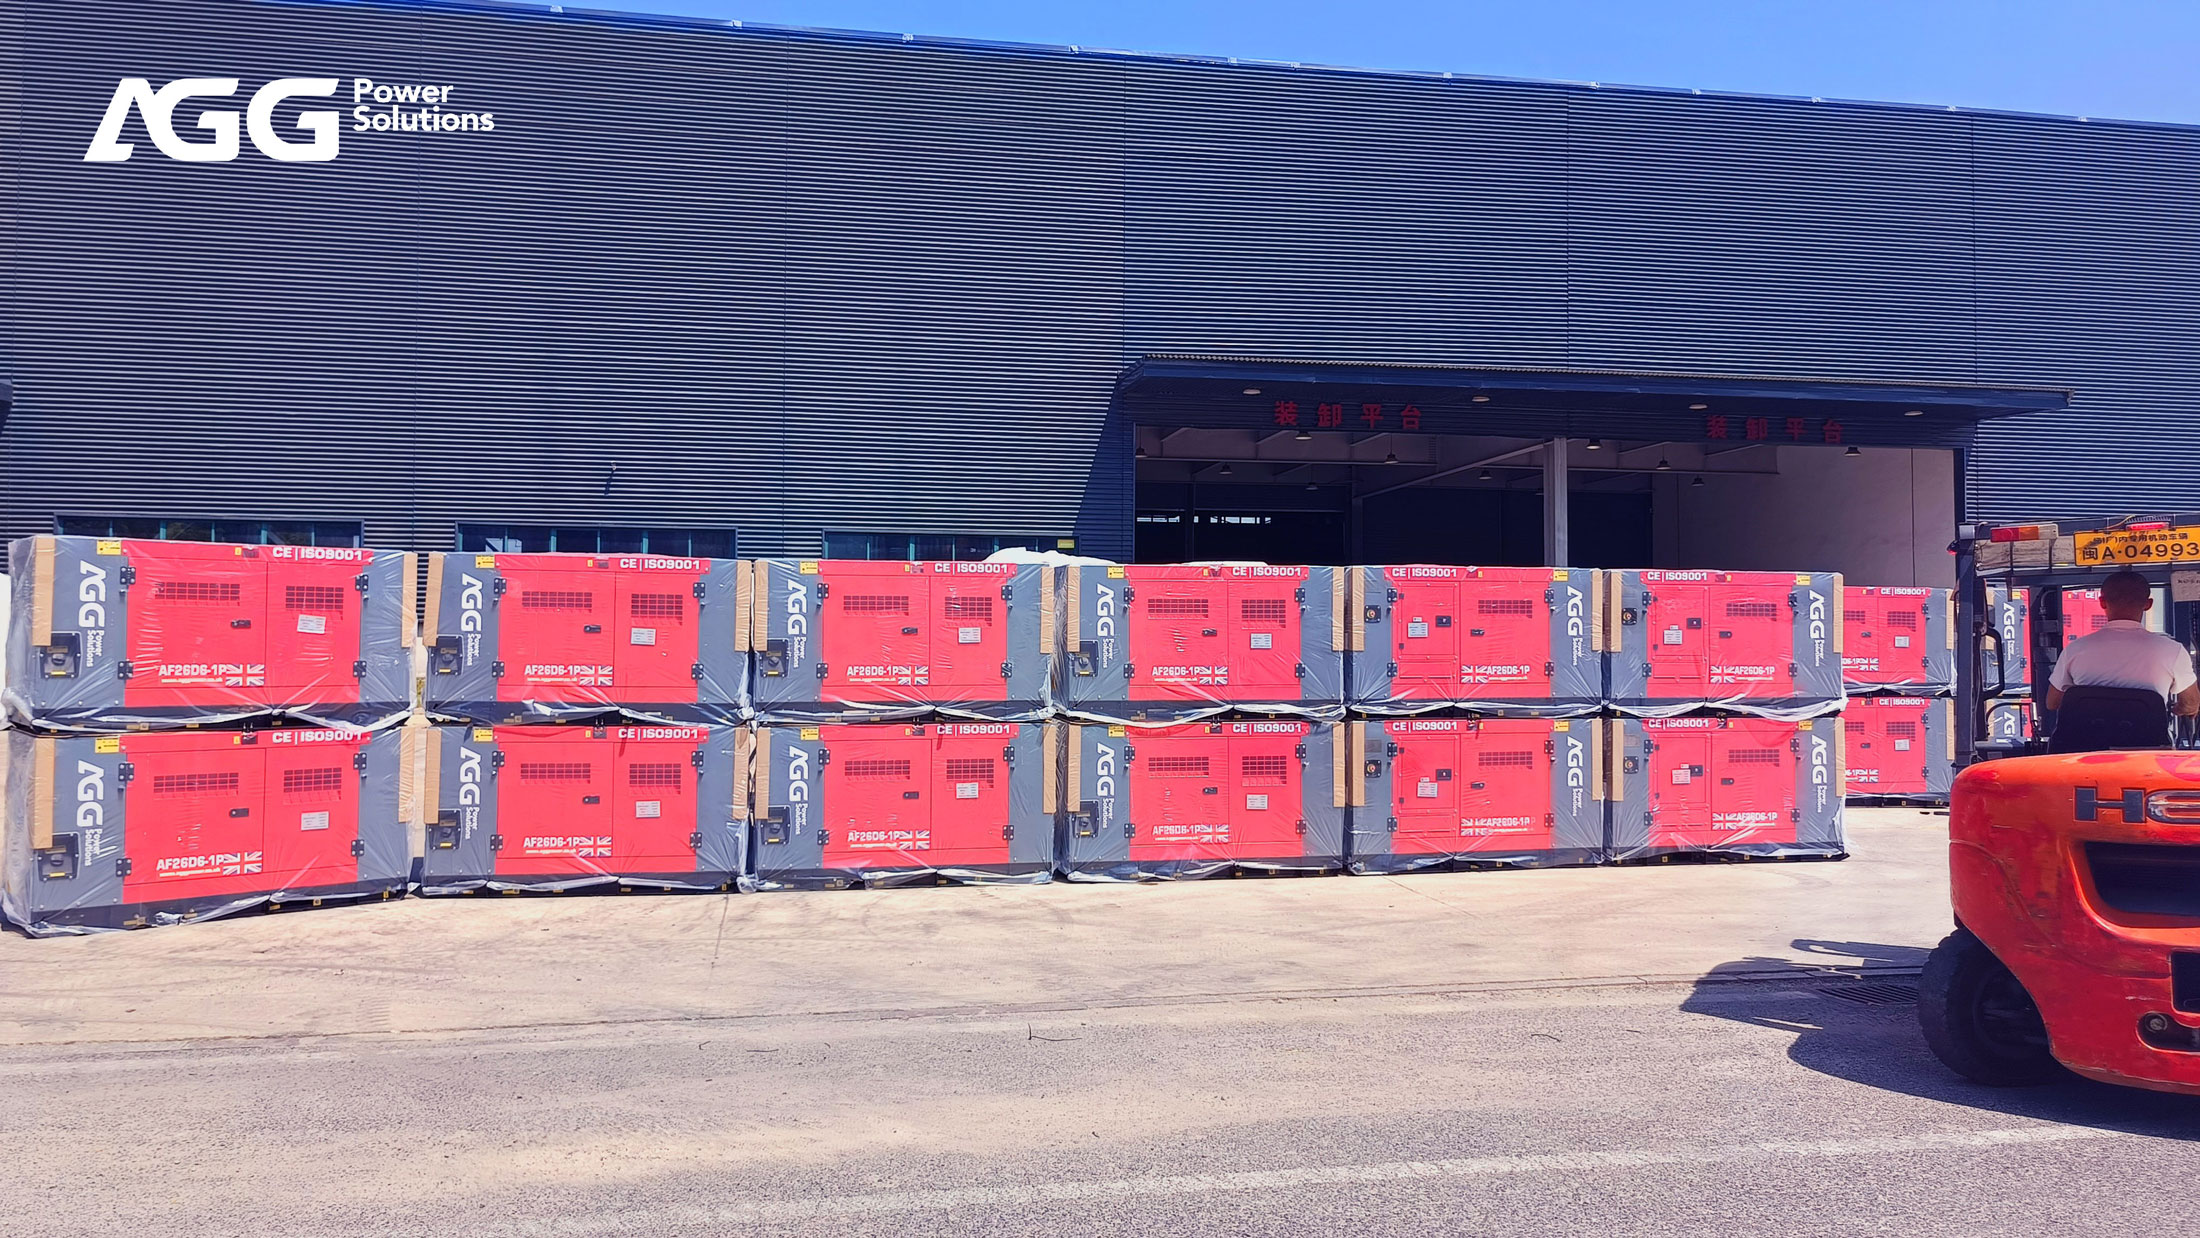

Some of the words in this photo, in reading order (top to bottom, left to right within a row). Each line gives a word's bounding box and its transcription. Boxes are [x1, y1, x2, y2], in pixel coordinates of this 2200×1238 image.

[1274, 400, 1422, 430] 装卸平台
[1706, 414, 1845, 444] 装卸平台
[79, 559, 106, 628] AGG
[461, 572, 483, 632] AGG
[787, 578, 807, 635] AGG
[1097, 583, 1115, 637] AGG
[1567, 585, 1583, 636] AGG
[1809, 589, 1825, 639] AGG
[95, 629, 105, 657] Power
[2003, 602, 2015, 640] AGG
[86, 629, 96, 668] Solutions
[459, 746, 481, 806] AGG
[789, 745, 809, 802] AGG
[1097, 742, 1115, 797] AGG
[1567, 735, 1583, 787] AGG
[1811, 734, 1828, 785] AGG
[77, 759, 104, 827] AGG
